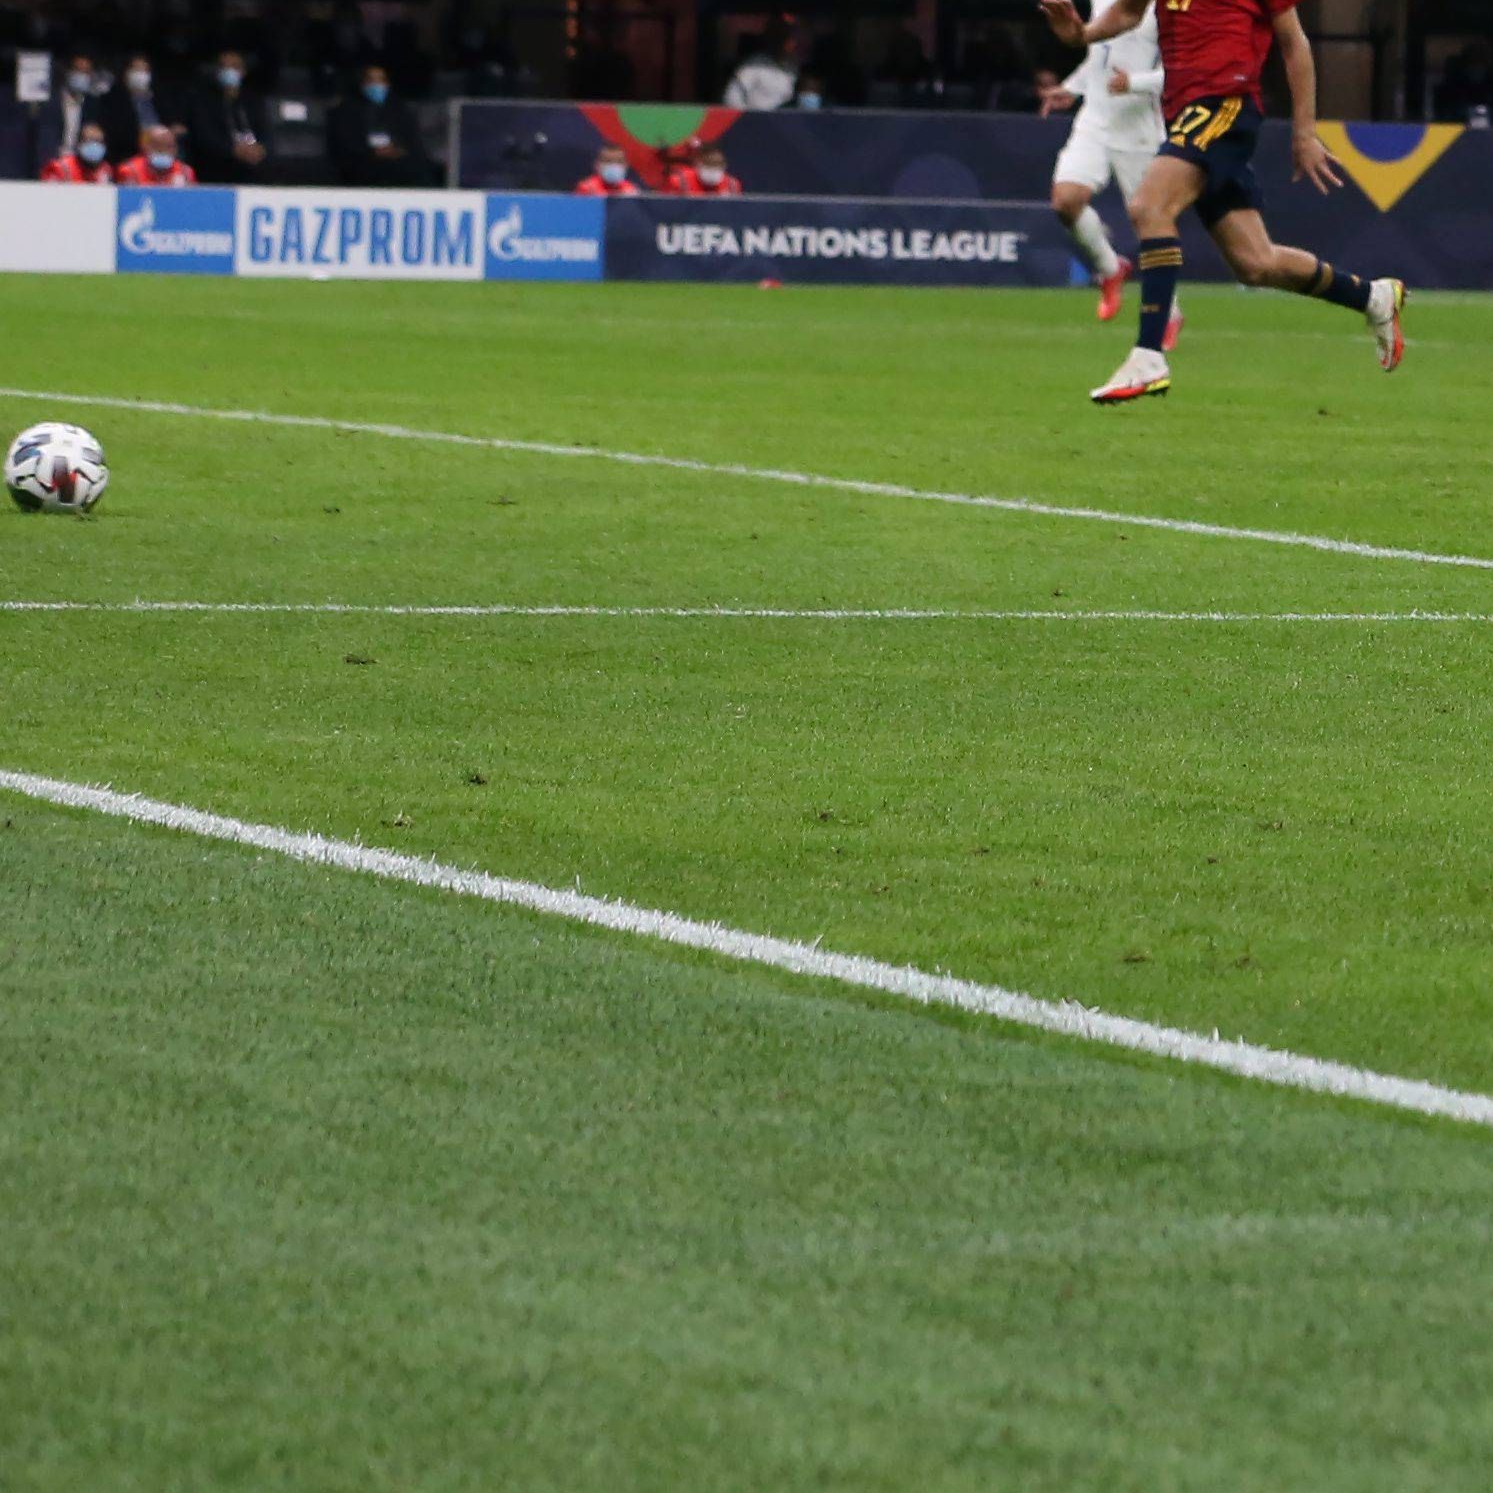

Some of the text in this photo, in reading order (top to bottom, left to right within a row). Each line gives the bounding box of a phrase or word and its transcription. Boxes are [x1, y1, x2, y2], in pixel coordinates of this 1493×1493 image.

[249, 206, 475, 266] GAZPROM
[656, 223, 1020, 262] UEFA NATIONS LEAGUE
